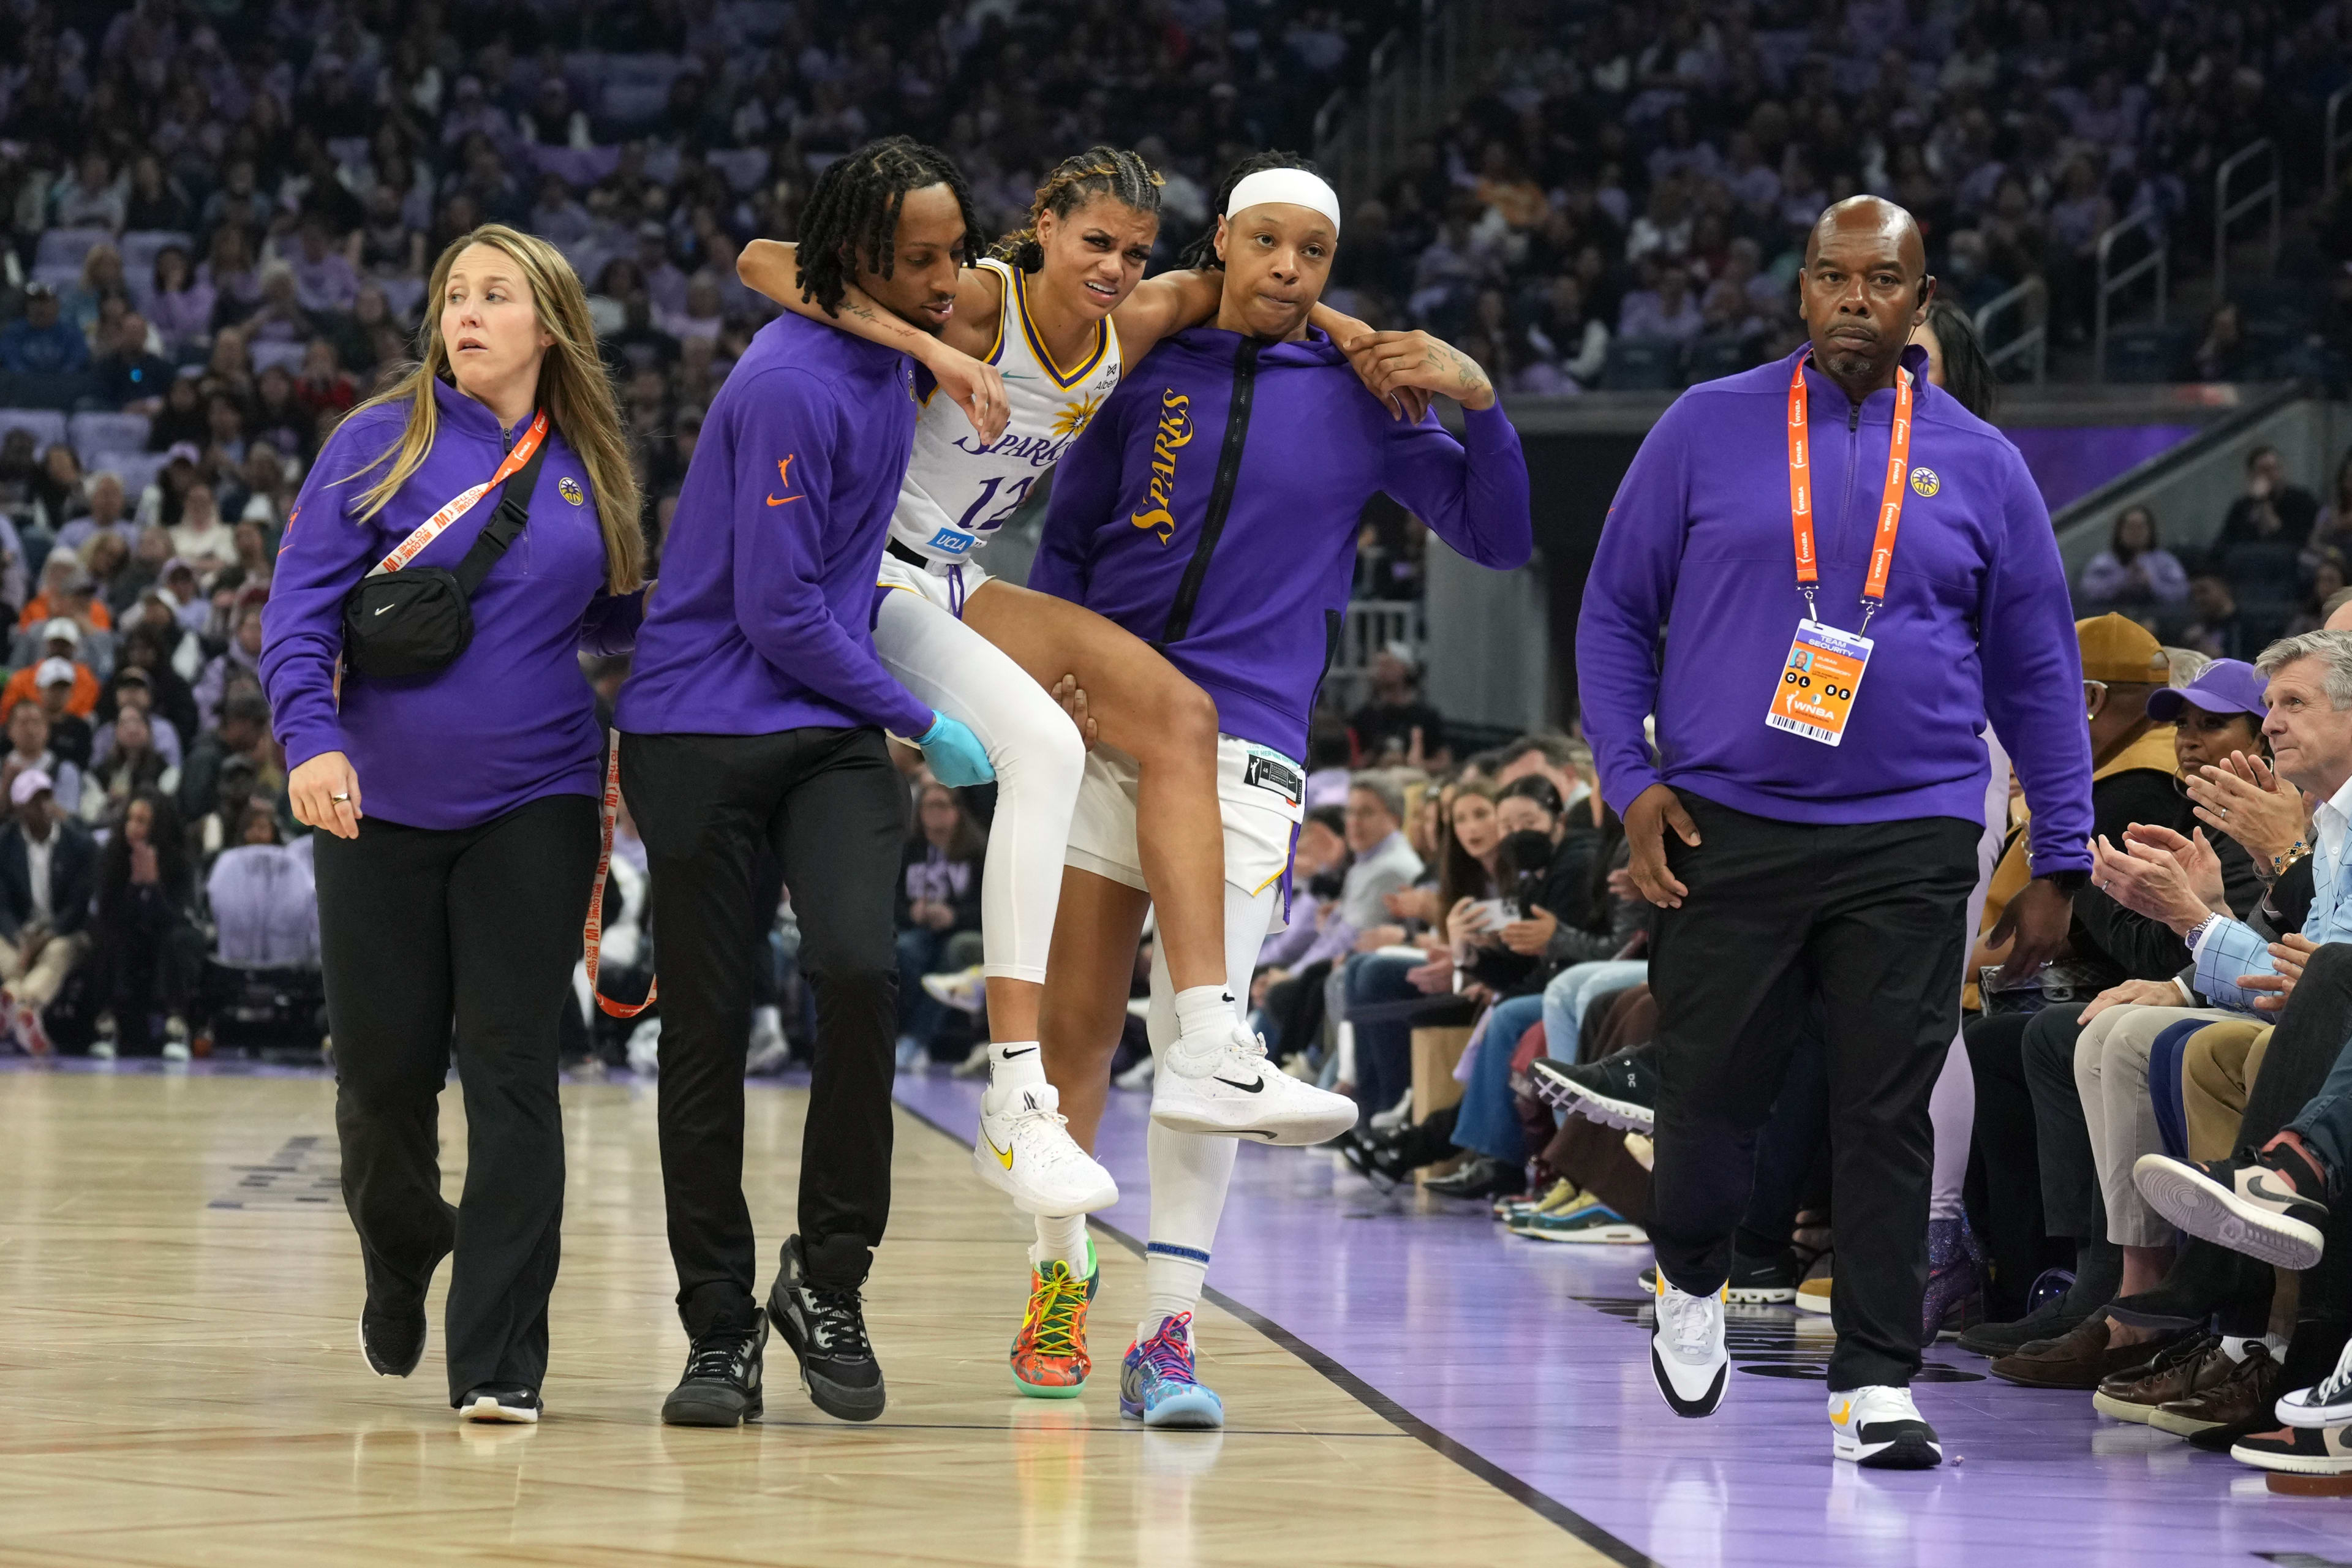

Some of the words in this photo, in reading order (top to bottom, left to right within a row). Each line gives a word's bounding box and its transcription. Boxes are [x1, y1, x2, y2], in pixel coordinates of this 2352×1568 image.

[1131, 388, 1193, 545] SPARKS
[1891, 462, 1900, 484] WNBA
[469, 488, 481, 496] TO
[450, 495, 469, 508] THE
[957, 477, 1035, 530] 12
[433, 512, 450, 529] W
[1883, 507, 1893, 532] WNBA
[415, 527, 428, 538] TO
[398, 538, 415, 554] THE
[402, 531, 433, 559] WELCOME
[937, 534, 967, 551] UCLA
[382, 557, 399, 573] W
[1874, 554, 1884, 578] WNBA
[1808, 638, 1855, 657] SECURITY
[1820, 635, 1847, 648] TEAM
[1794, 700, 1834, 720] WNBA
[605, 794, 618, 808] W
[591, 883, 603, 919] WELCOME
[585, 929, 599, 941] W
[586, 946, 592, 958] TO
